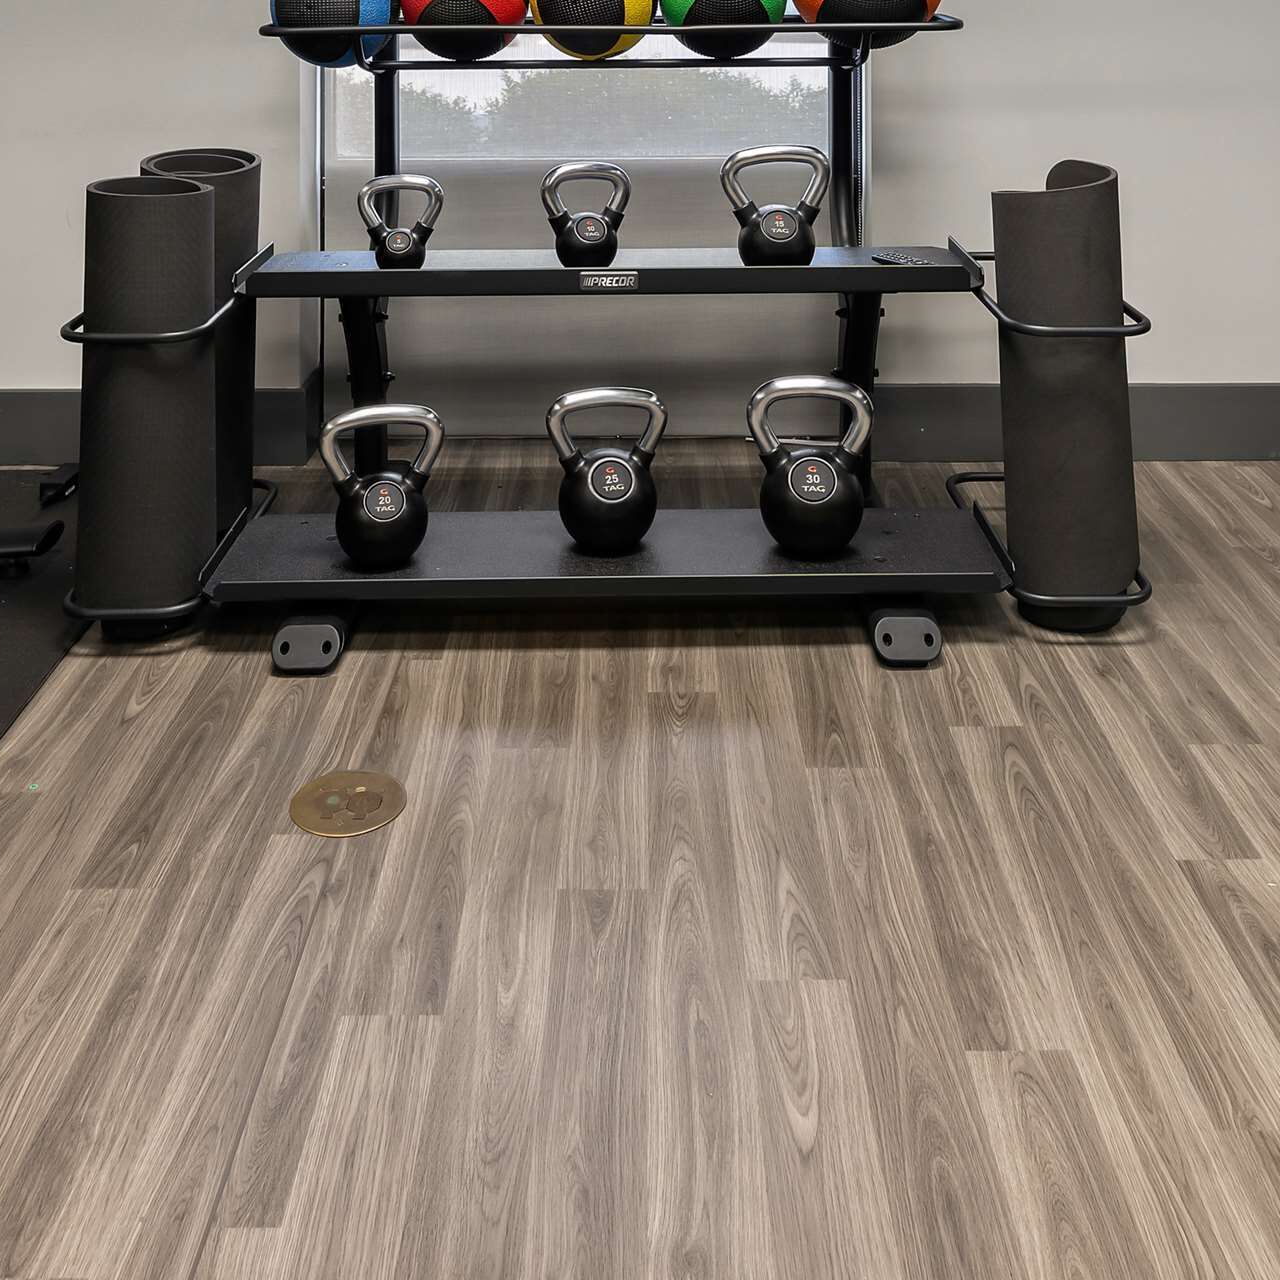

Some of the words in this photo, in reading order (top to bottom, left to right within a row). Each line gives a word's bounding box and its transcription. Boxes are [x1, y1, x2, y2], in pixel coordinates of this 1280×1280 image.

[590, 276, 635, 287] PRECOR
[604, 473, 620, 484] 25
[805, 474, 821, 484] 30
[602, 483, 625, 492] TAG
[801, 485, 826, 494] TAG
[378, 495, 392, 505] 20
[375, 504, 396, 513] TAG
